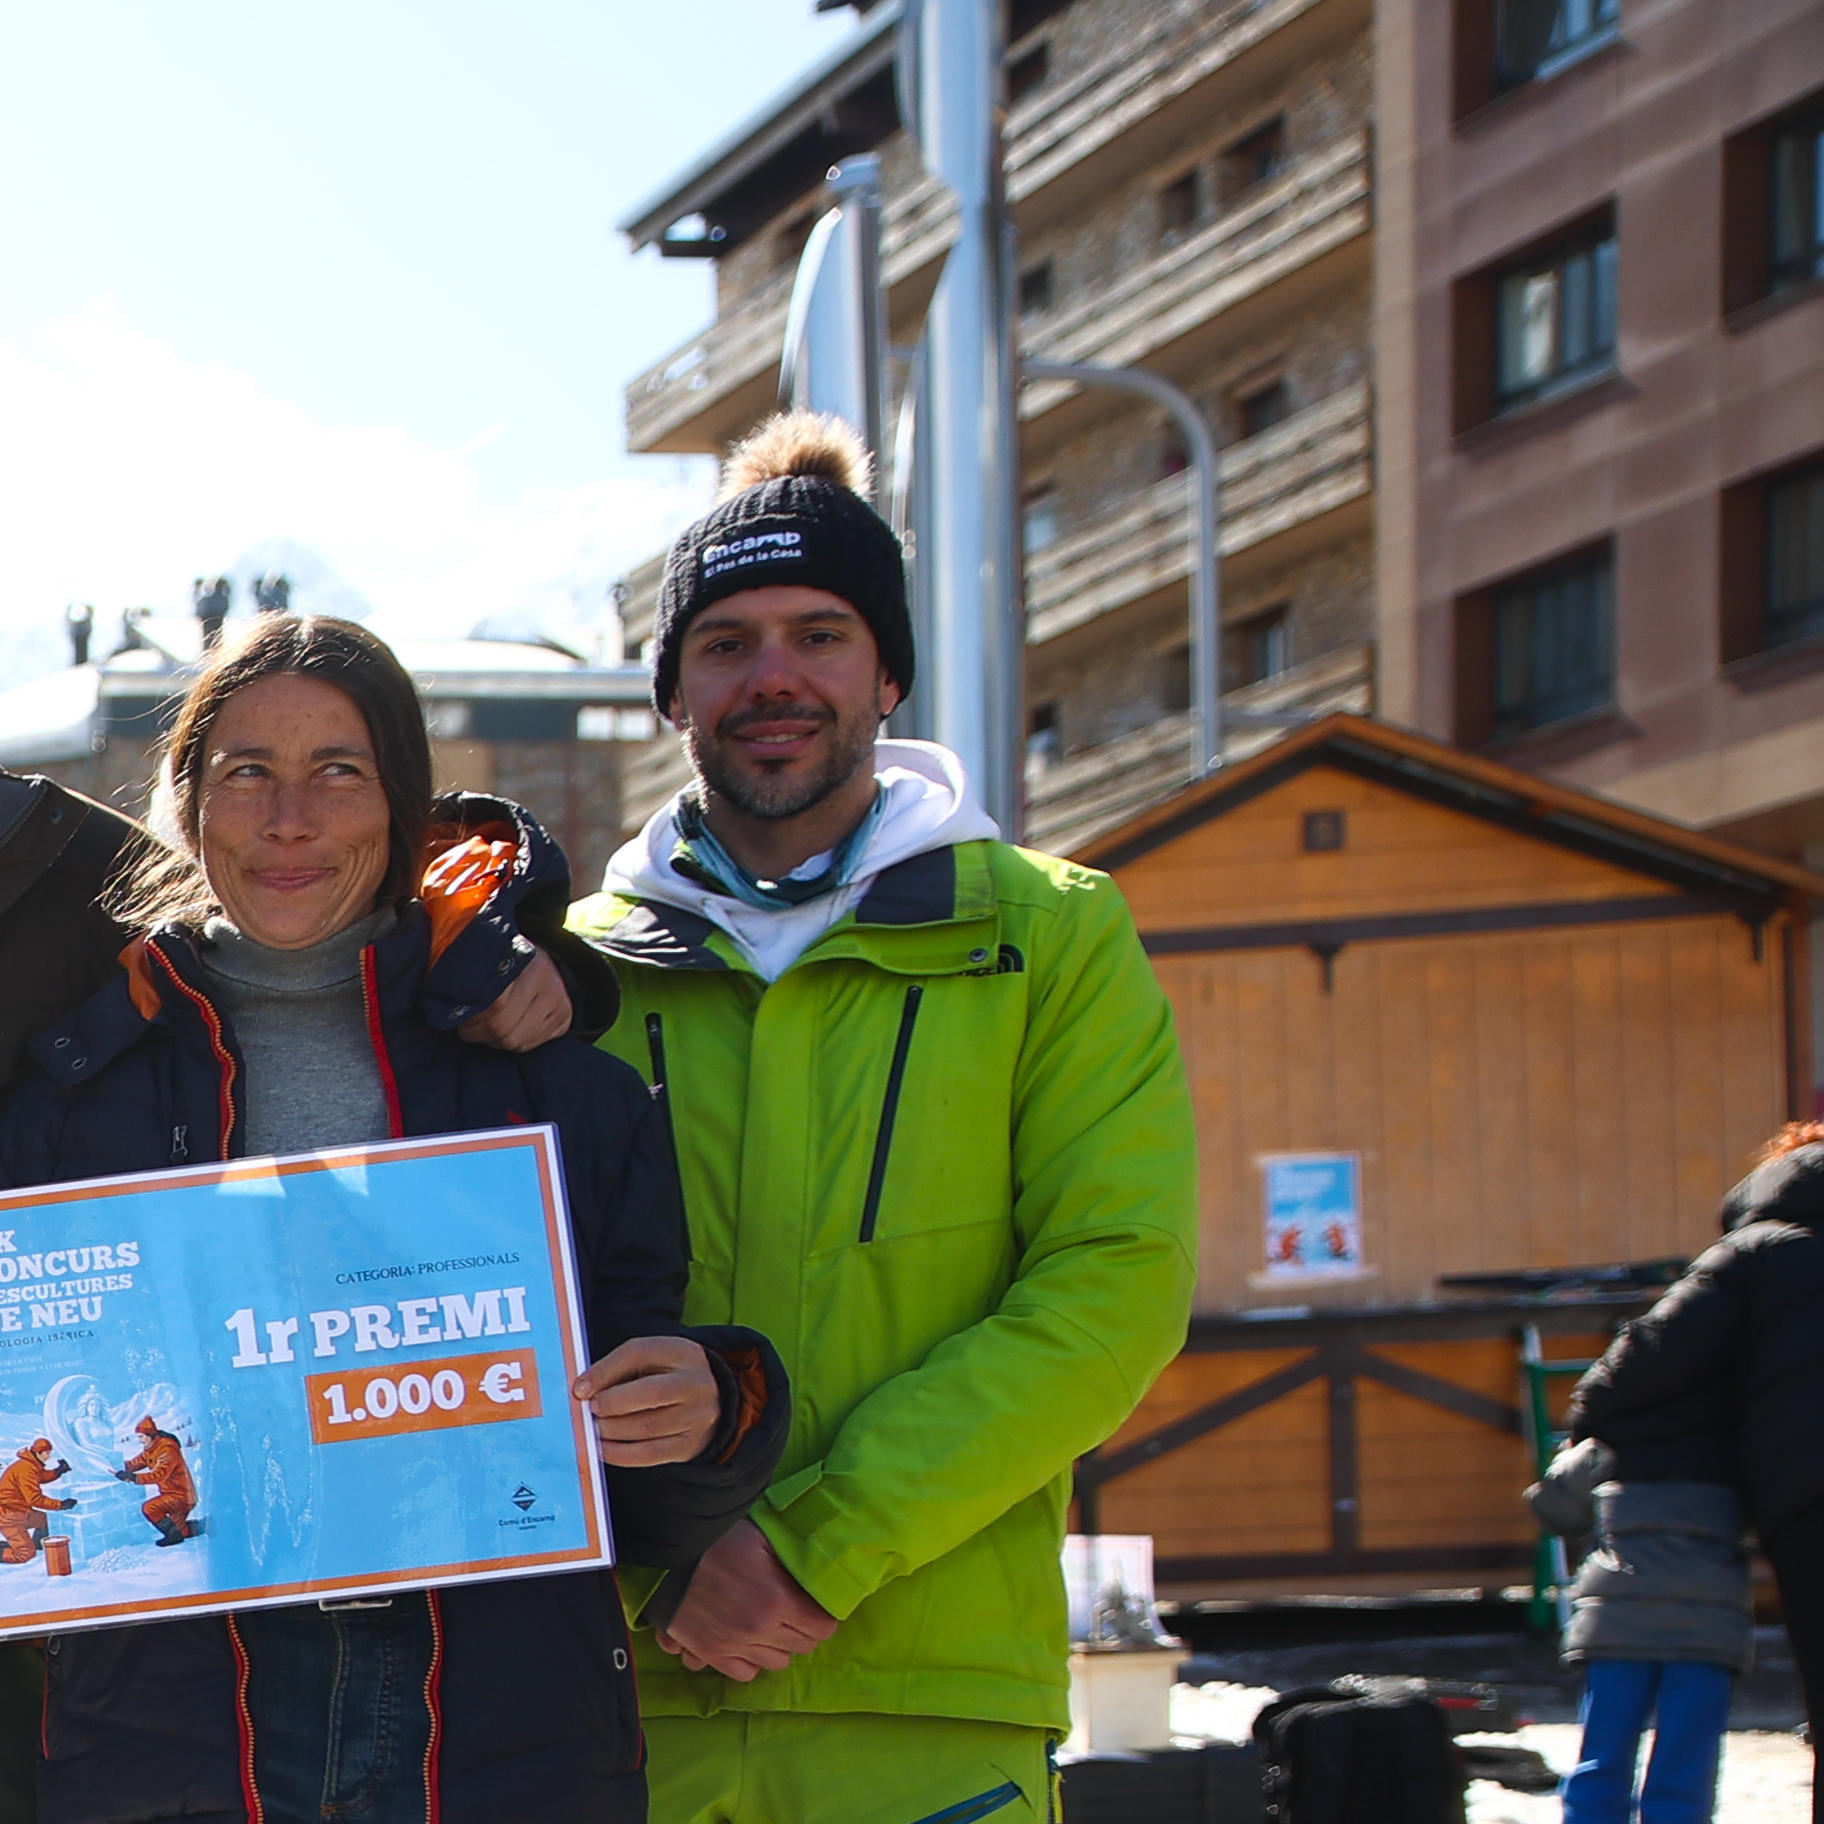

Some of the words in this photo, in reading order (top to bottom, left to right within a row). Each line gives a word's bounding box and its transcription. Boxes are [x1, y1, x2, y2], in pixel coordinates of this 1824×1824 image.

[737, 554, 754, 566] de
[770, 549, 802, 559] Casa
[335, 1265, 416, 1285] CATEGORIA:
[418, 1252, 520, 1275] PROFESSIONALS
[29, 1296, 103, 1329] NEU
[224, 1308, 299, 1368] 1r
[309, 1286, 531, 1358] PREMI
[322, 1369, 466, 1425] 1.000
[478, 1361, 526, 1403] €
